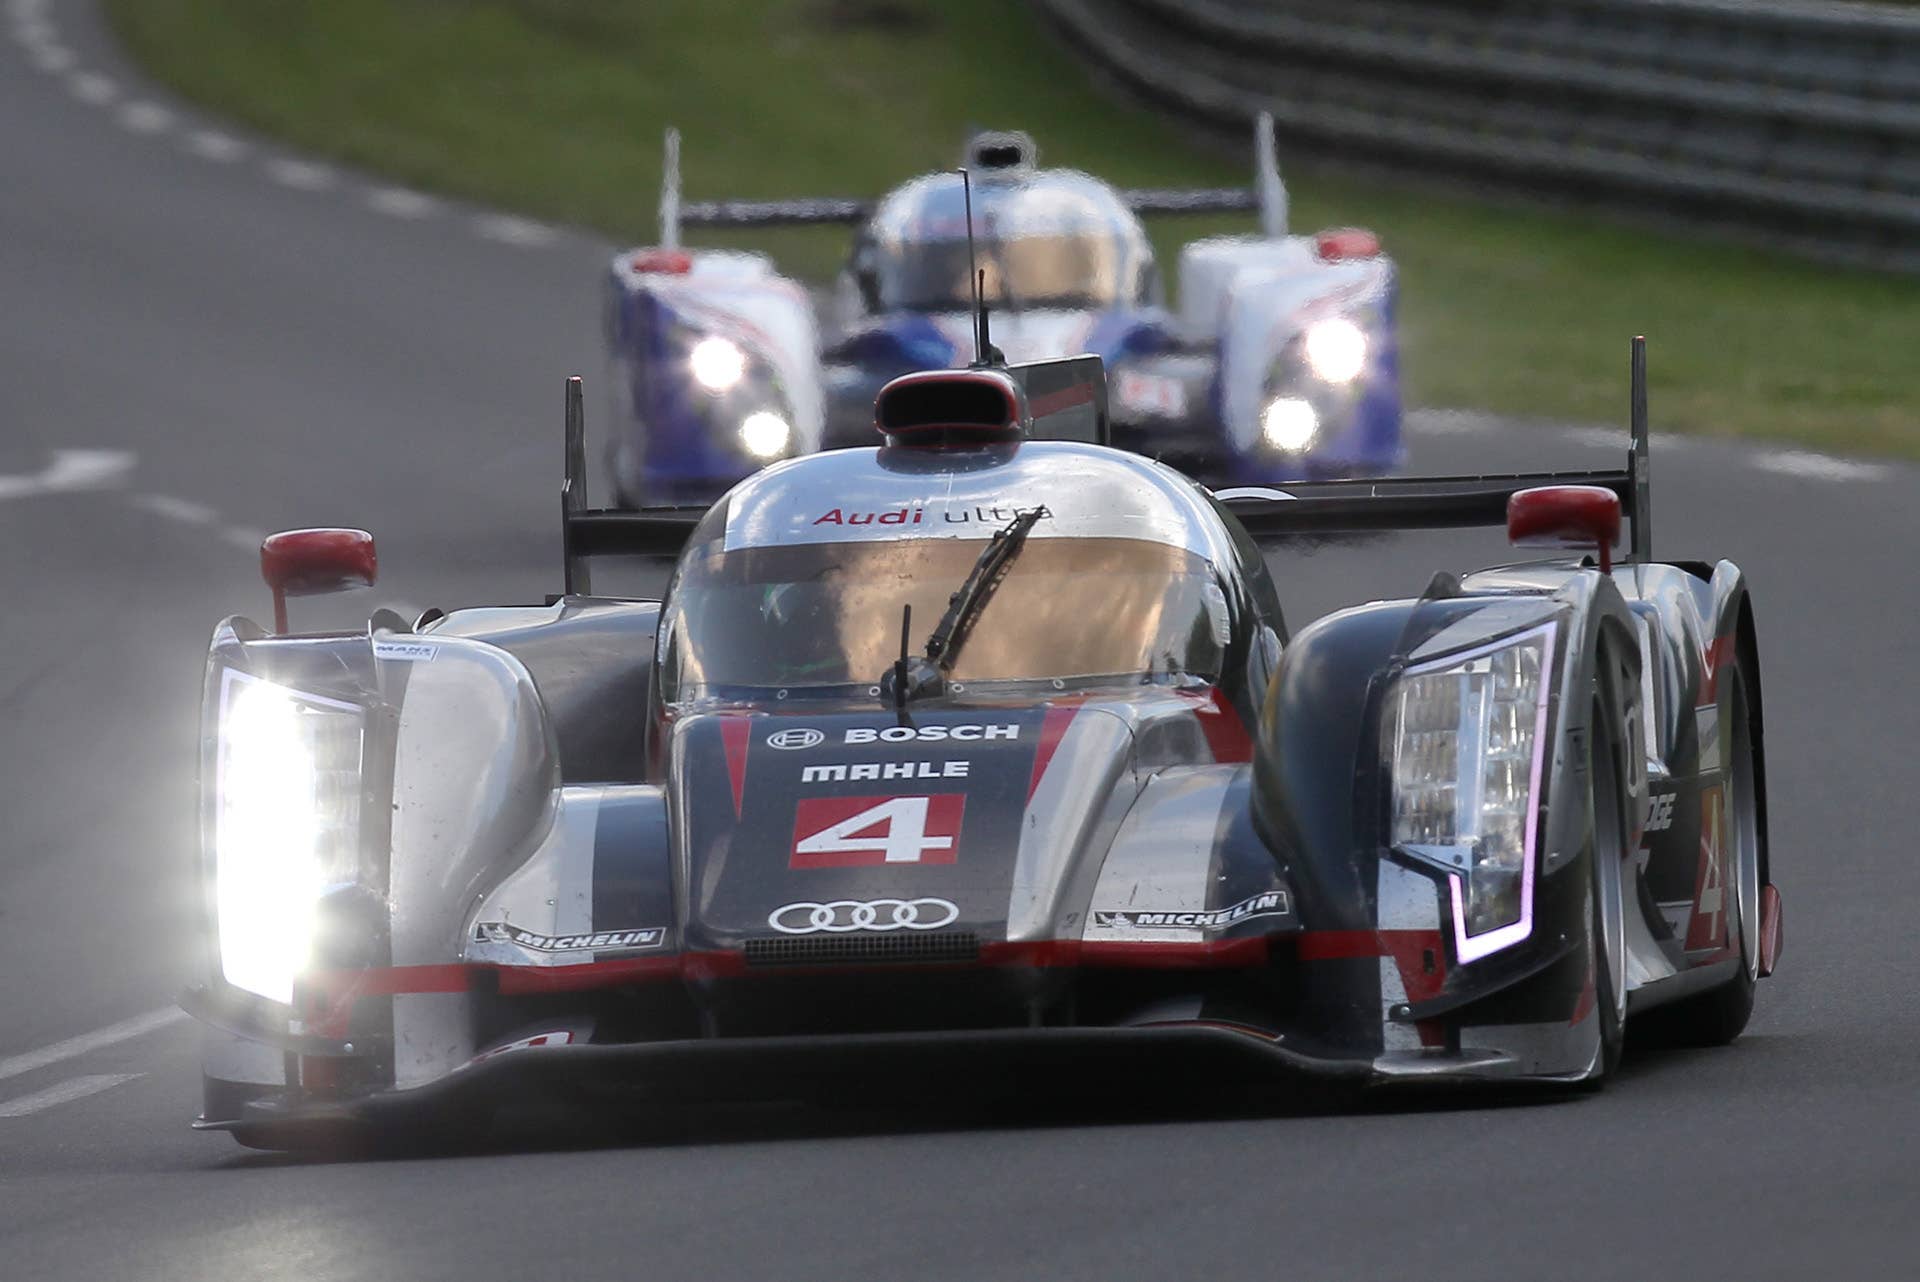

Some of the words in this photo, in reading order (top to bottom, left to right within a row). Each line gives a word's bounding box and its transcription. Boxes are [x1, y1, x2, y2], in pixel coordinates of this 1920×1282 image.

[812, 508, 923, 525] Audi
[944, 505, 1053, 524] ultra
[844, 725, 1019, 744] BOSCH
[801, 761, 969, 782] MAHLE
[1644, 793, 1677, 831] DGE
[796, 797, 953, 862] 4
[1137, 895, 1278, 925] MICHELIN
[516, 931, 657, 949] MICHELIN
